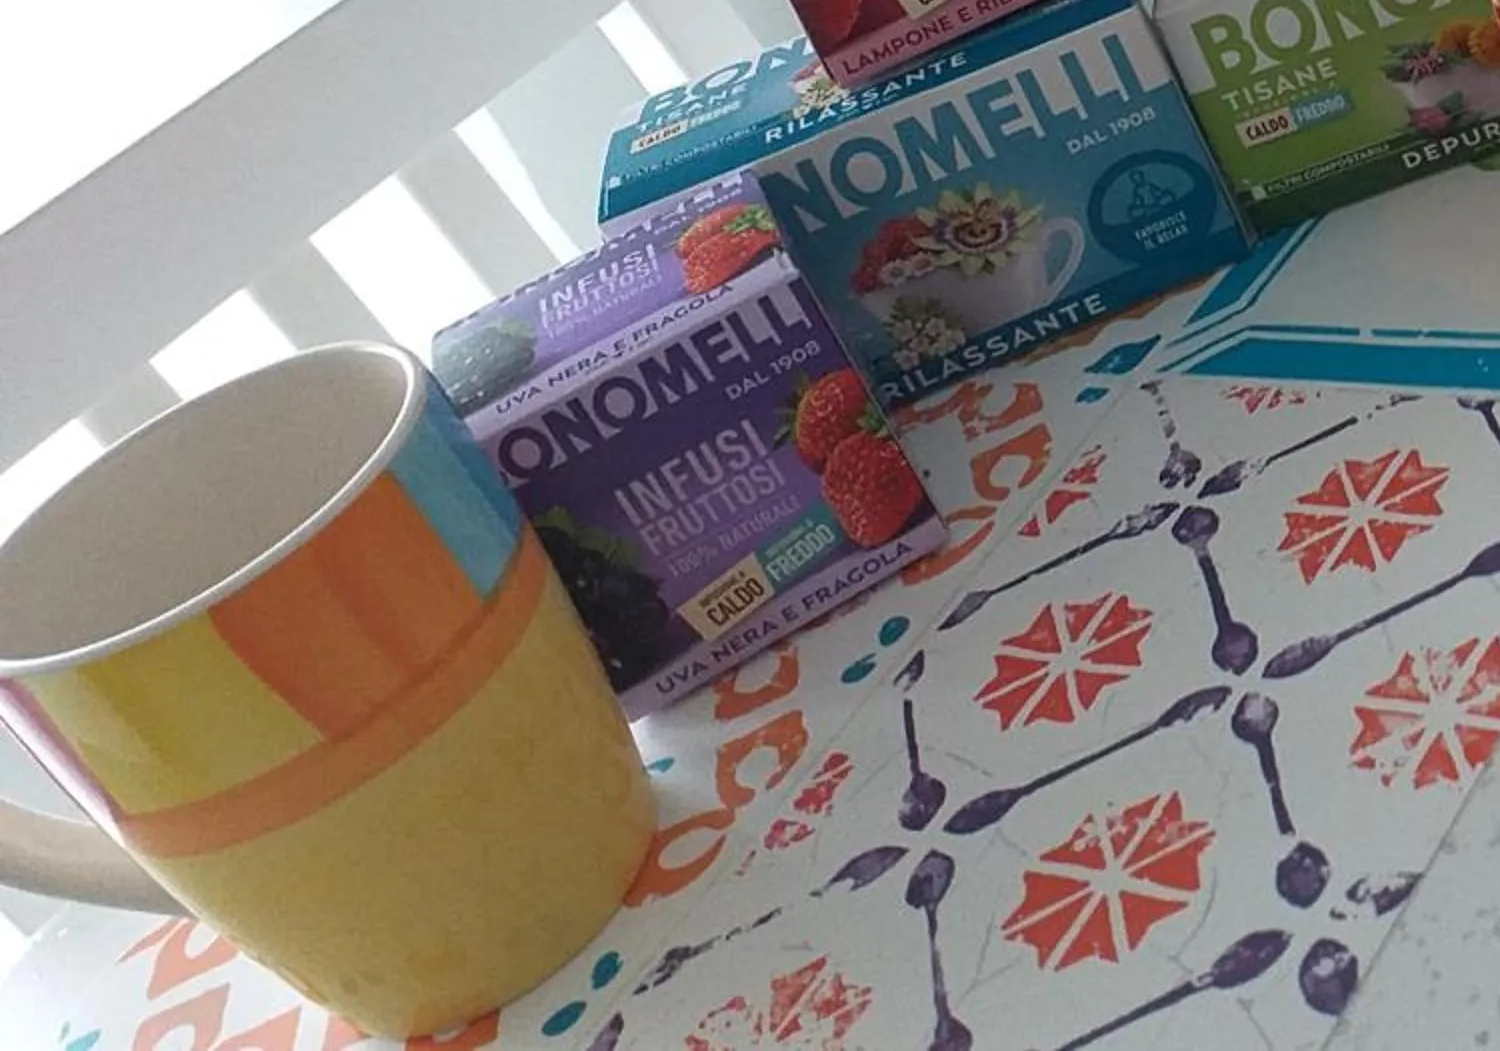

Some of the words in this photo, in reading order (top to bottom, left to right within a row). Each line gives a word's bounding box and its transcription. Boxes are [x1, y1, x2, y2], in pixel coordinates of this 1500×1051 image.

[842, 14, 953, 76] LAMPONE
[957, 5, 972, 24] E
[765, 52, 968, 145] RILASSANTE
[1221, 56, 1338, 111] TISANE
[759, 33, 1145, 237] NOMELLI
[1066, 129, 1108, 156] DAL
[1108, 106, 1157, 136] 1908
[1246, 115, 1289, 140] CALDO
[539, 243, 656, 313] INFUSI
[496, 386, 542, 414] UVA
[632, 285, 733, 342] FRAGOLA
[498, 278, 815, 487] ONOMELLI
[725, 371, 770, 400] DAL
[770, 340, 820, 374] 1908
[879, 293, 1107, 401] RILASSANTE
[615, 418, 769, 526] INFUSI
[641, 457, 785, 557] FRUTTOSI
[766, 524, 835, 582] FREDDO
[655, 659, 710, 697] UVA
[713, 617, 778, 664] NERA
[781, 604, 800, 623] E
[801, 540, 913, 611] FRAGOLA
[706, 577, 764, 626] CALDO
